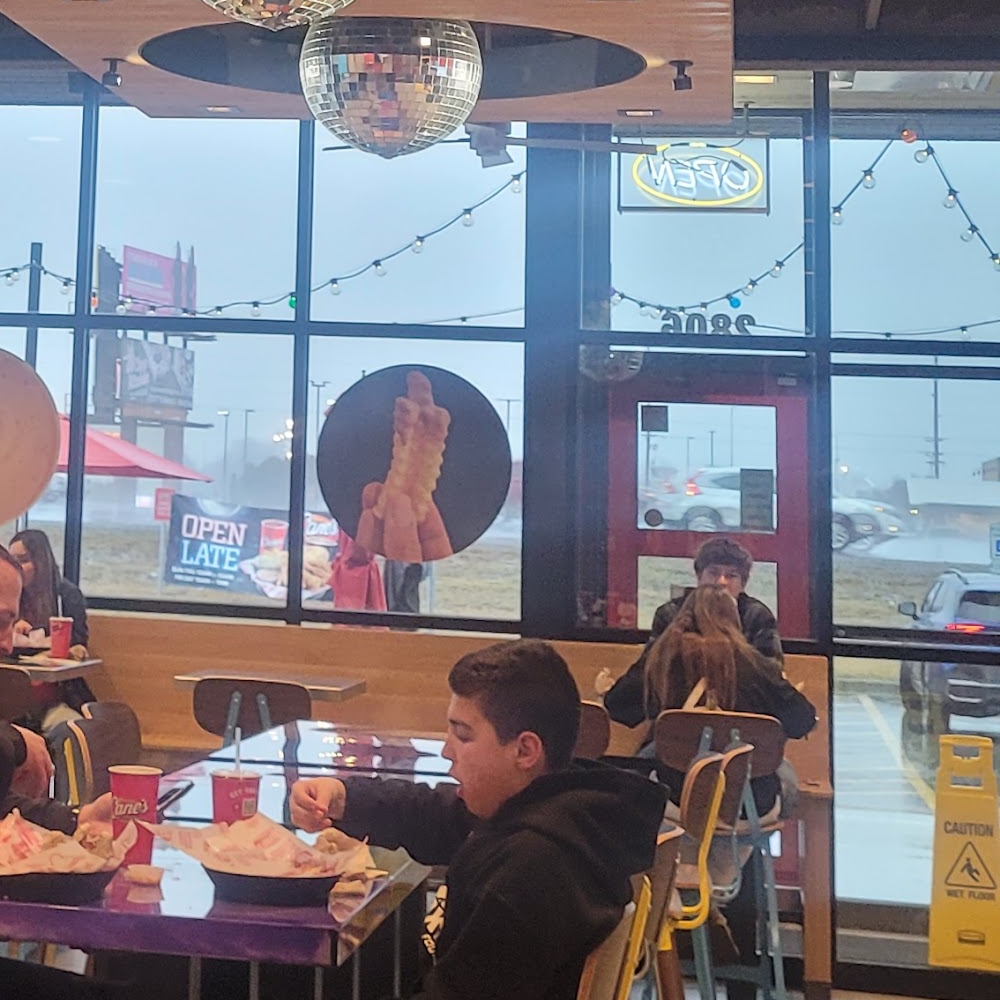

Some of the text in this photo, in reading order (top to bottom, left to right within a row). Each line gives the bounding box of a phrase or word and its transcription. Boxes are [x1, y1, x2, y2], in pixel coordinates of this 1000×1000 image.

[181, 514, 248, 547] OPEN
[180, 540, 240, 571] LATE
[944, 820, 994, 837] CAUTION
[946, 888, 996, 901] WET FLOOR
